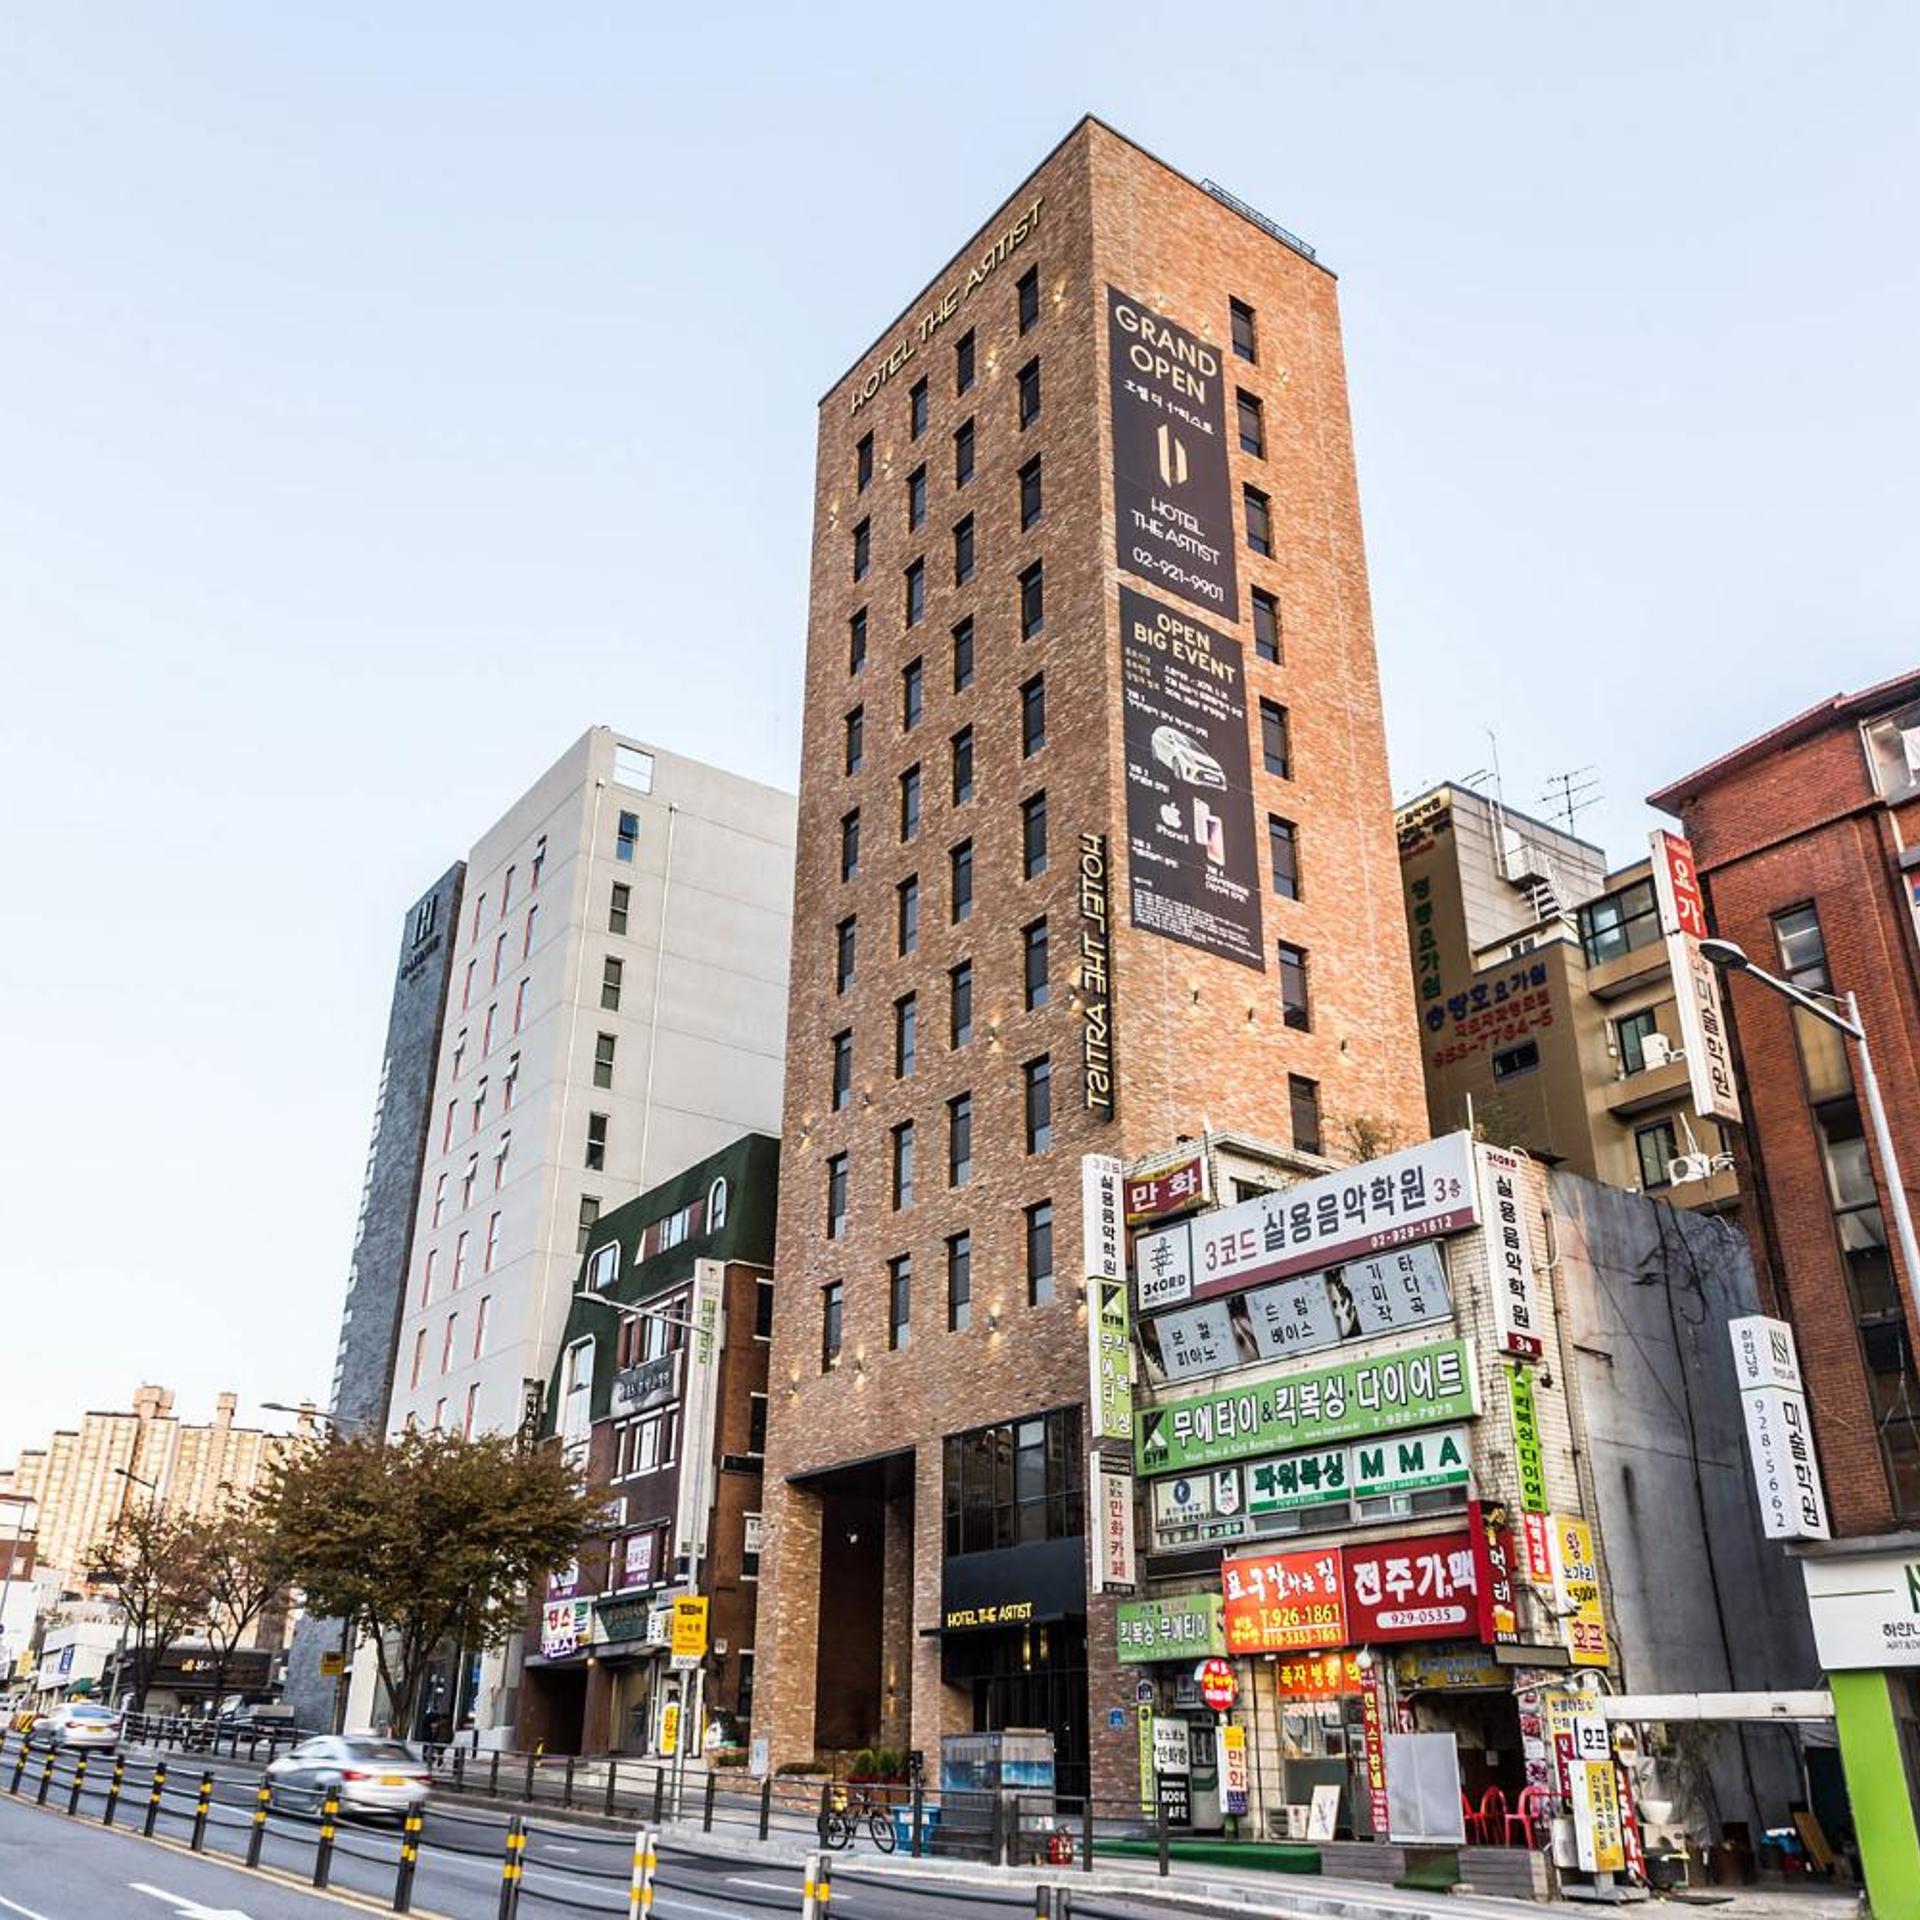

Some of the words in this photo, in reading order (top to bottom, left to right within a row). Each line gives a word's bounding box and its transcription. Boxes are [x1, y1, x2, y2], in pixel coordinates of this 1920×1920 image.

[850, 339, 915, 415] HOTEL
[918, 286, 958, 342] THE
[1115, 305, 1217, 377] GRAND
[1130, 345, 1205, 404] OPEN
[1131, 509, 1163, 539] THE
[1151, 497, 1205, 537] HOTEL
[1132, 547, 1224, 601] 02-921-9901
[1134, 622, 1167, 650] BIG
[1173, 638, 1236, 684] EVENT
[1157, 613, 1210, 651] OPEN
[1132, 1168, 1198, 1212] 만화
[1205, 1228, 1258, 1271] 3코드
[1263, 1165, 1426, 1253] 실용음악학원
[1496, 1175, 1530, 1329] 실용음악학원
[1144, 1449, 1168, 1465] GYM
[1254, 1452, 1345, 1497] 파워복싱
[1353, 1549, 1478, 1606] 전주가맥
[947, 1610, 978, 1628] HOTEL
[978, 1606, 997, 1623] THE
